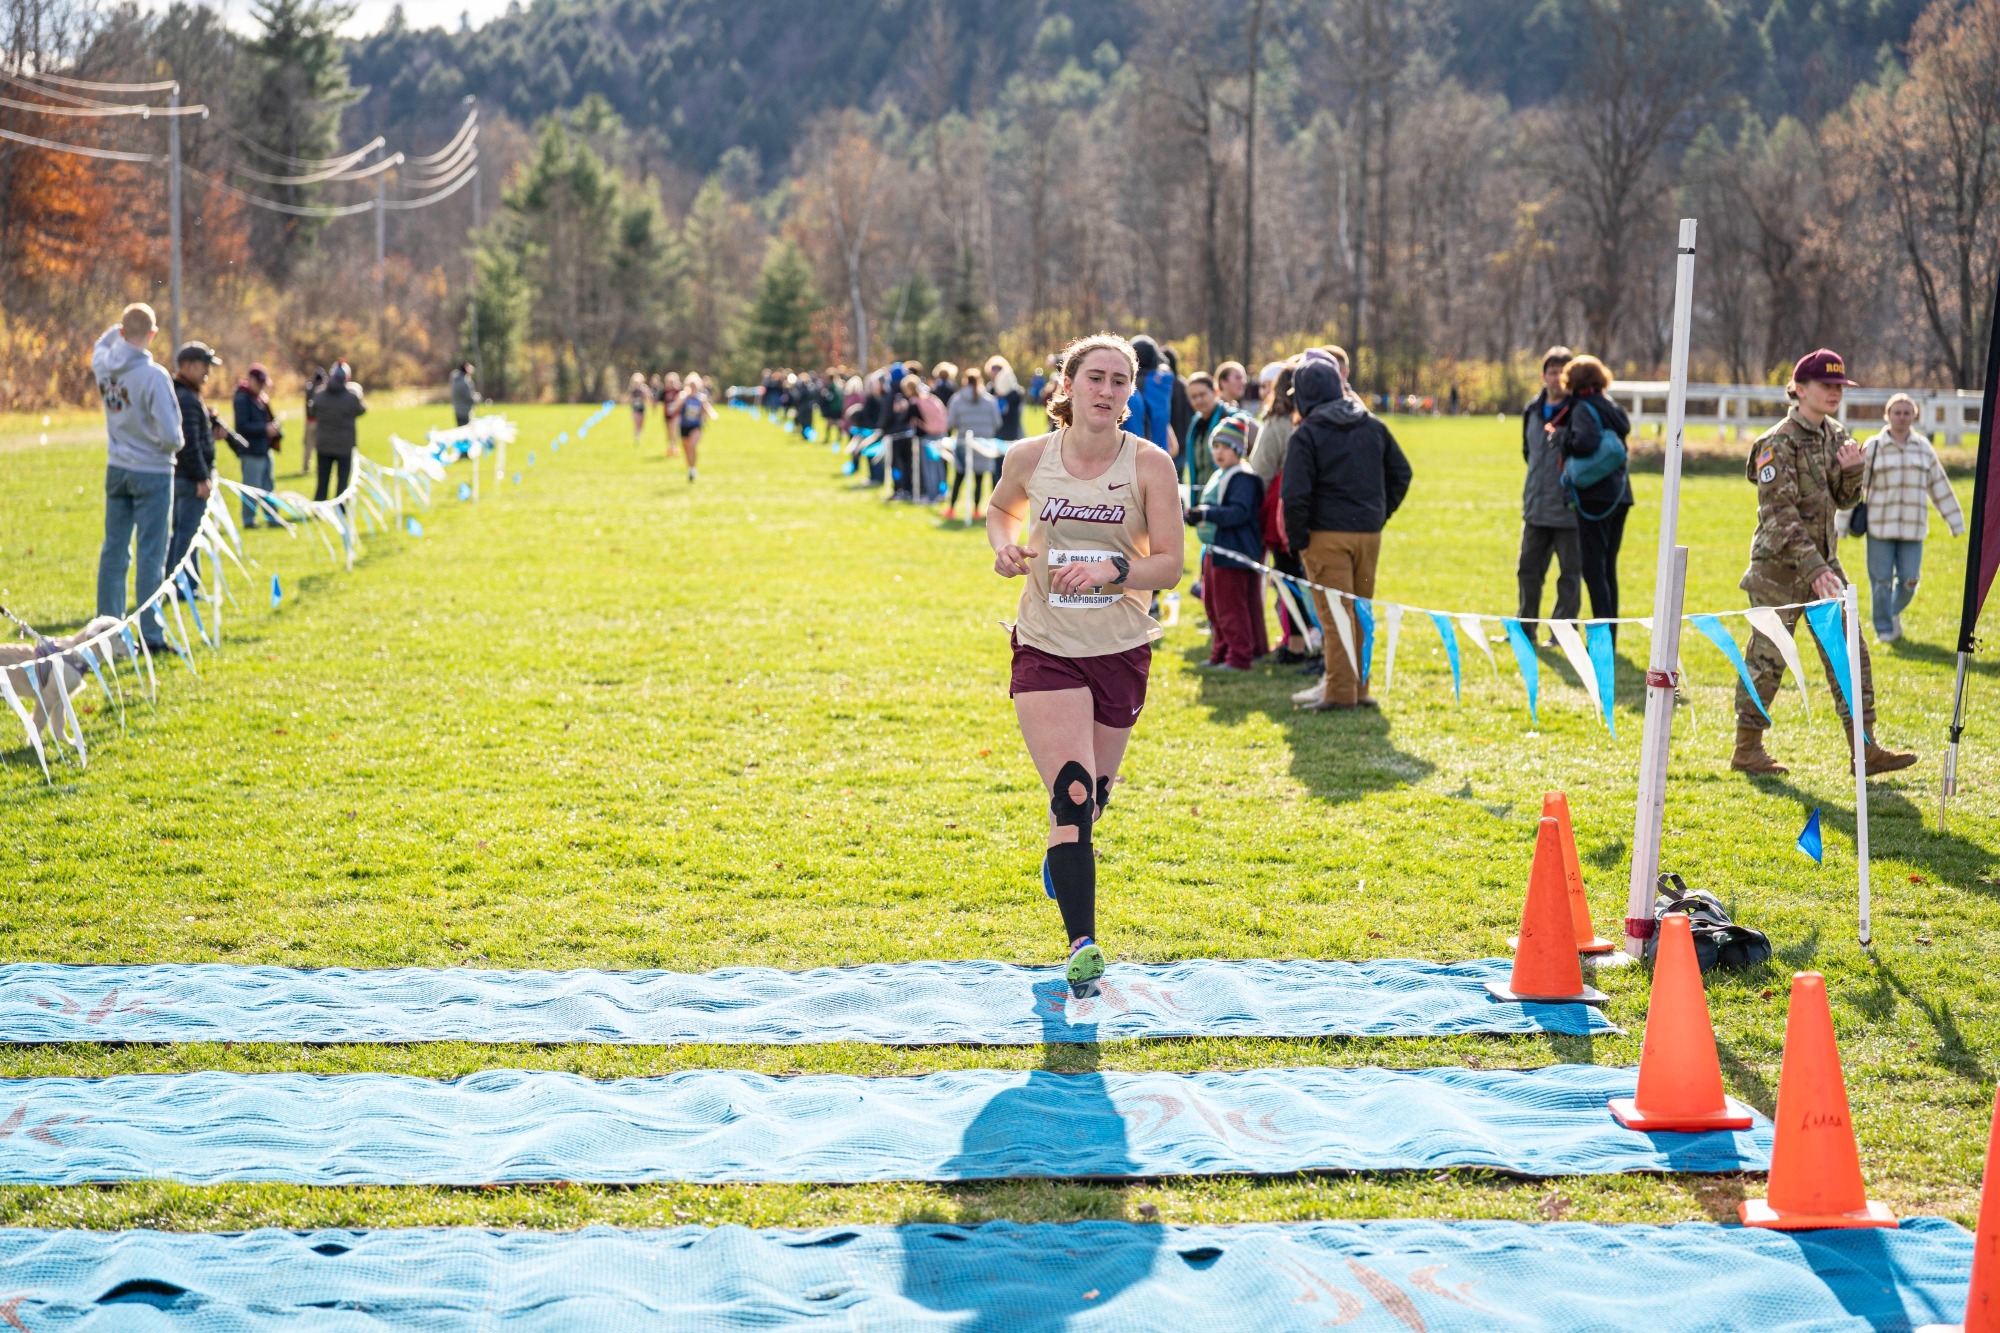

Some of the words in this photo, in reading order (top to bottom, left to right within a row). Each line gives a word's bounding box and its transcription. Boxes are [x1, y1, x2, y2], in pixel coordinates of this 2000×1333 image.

[1040, 497, 1125, 527] Norwich
[1070, 555, 1089, 563] GNAC
[1059, 595, 1113, 604] CHAMPIONSHIPS
